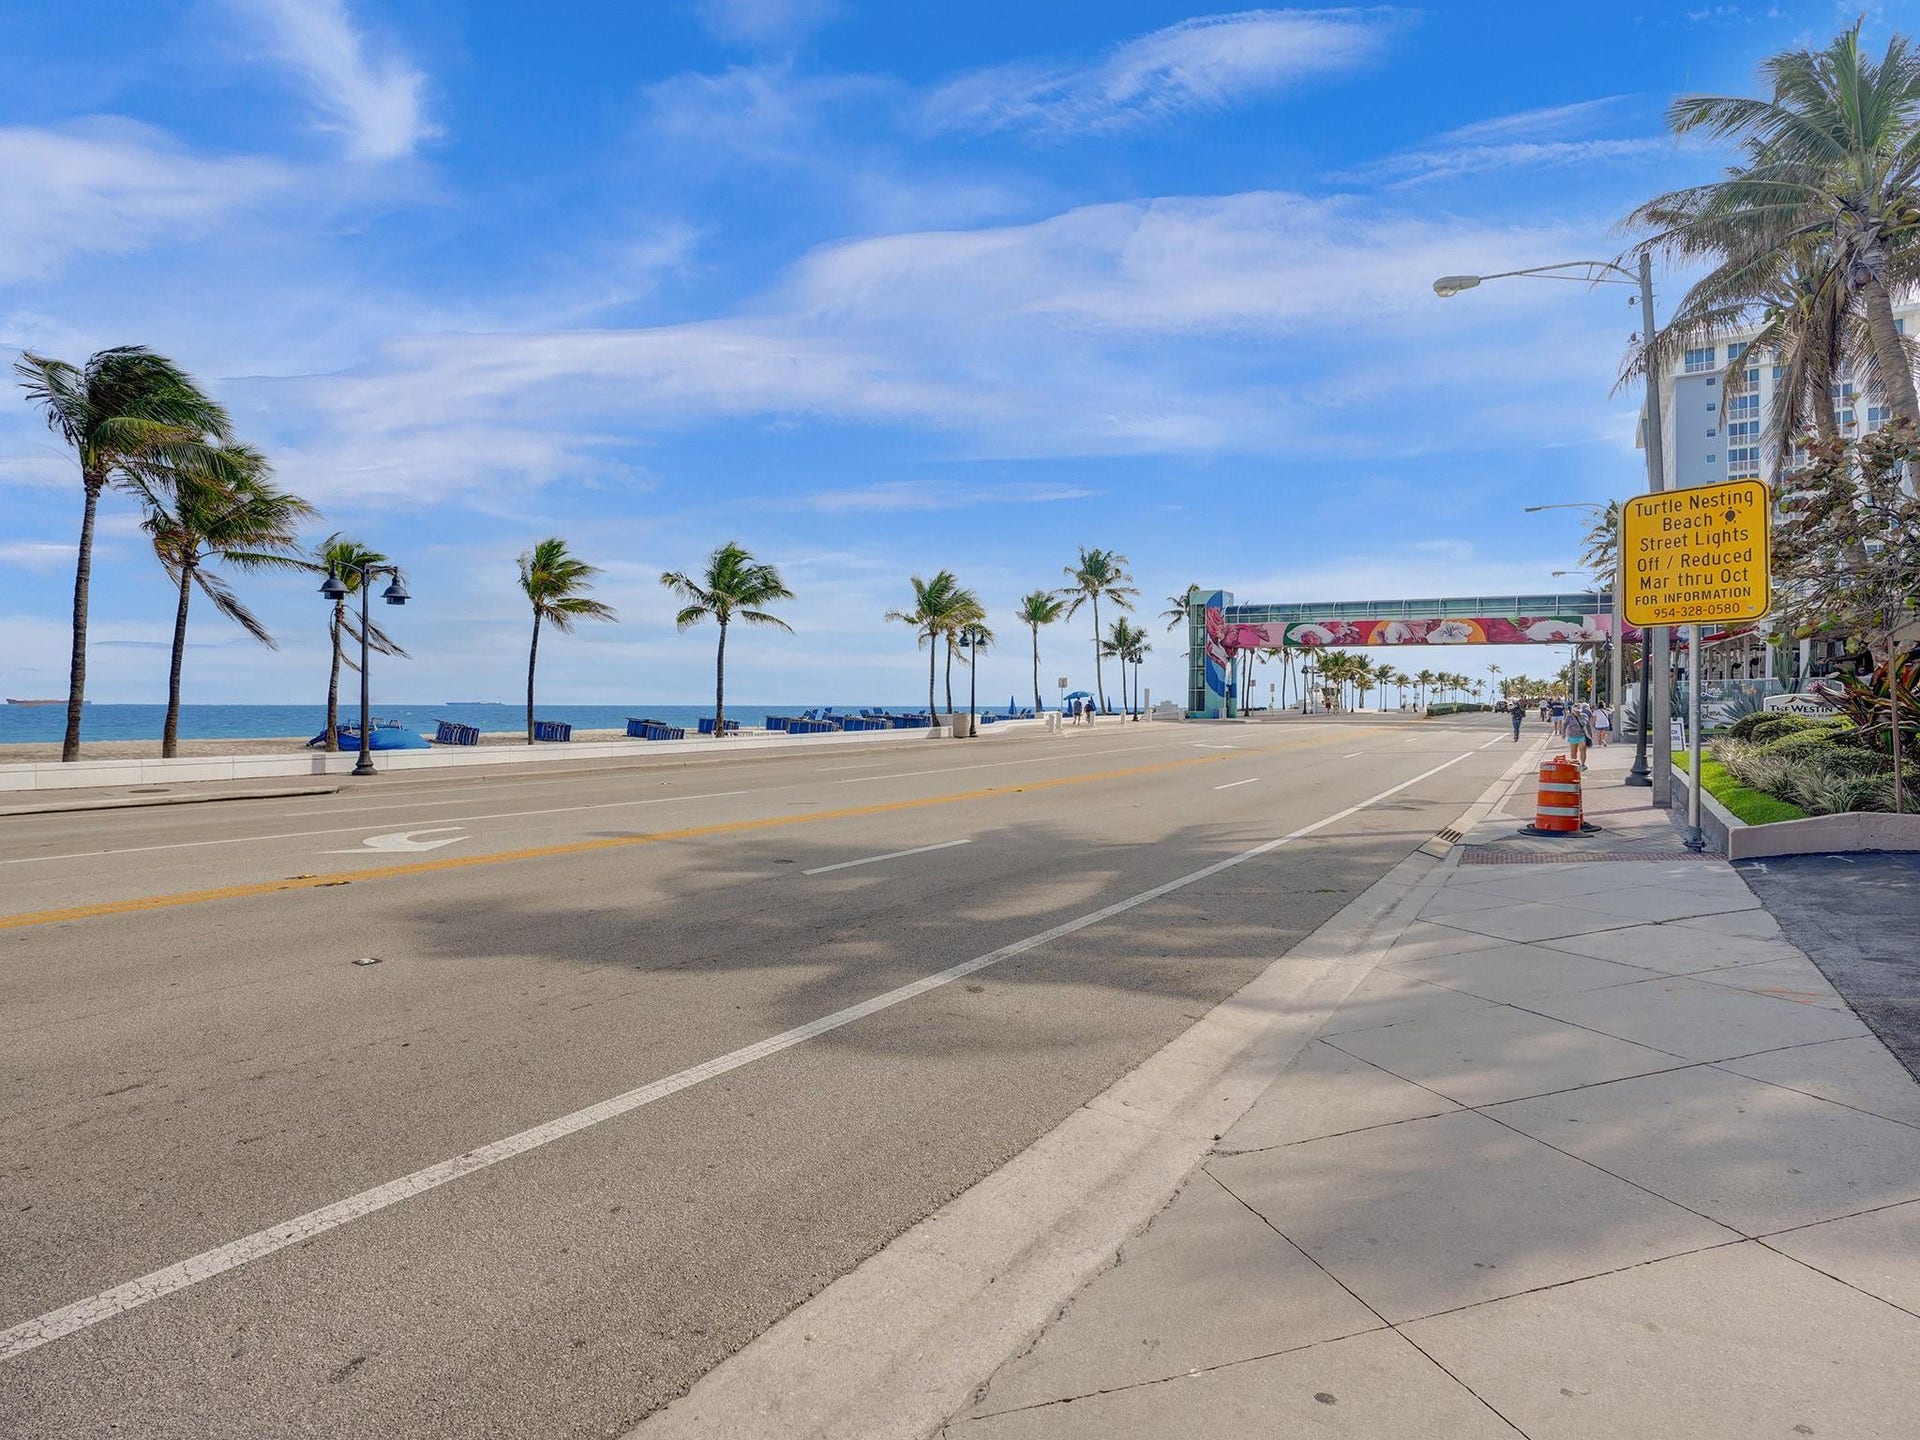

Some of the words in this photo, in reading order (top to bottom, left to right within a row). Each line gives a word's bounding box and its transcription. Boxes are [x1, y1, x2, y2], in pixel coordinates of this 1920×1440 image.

[1635, 500, 1682, 517] Turtle
[1689, 490, 1753, 509] Nesting
[1663, 513, 1712, 531] Beach
[1640, 533, 1688, 551] Street
[1695, 528, 1748, 548] Lights
[1637, 556, 1660, 572] Off
[1666, 555, 1673, 570] /
[1681, 548, 1752, 568] Reduced
[1640, 576, 1669, 590] Mar
[1678, 572, 1713, 587] thru
[1721, 568, 1749, 583] Oct
[1635, 595, 1658, 606] FOR
[1664, 587, 1751, 603] INFORMATION
[1653, 603, 1740, 618] 954-328-0580
[1791, 704, 1833, 713] WESTIN
